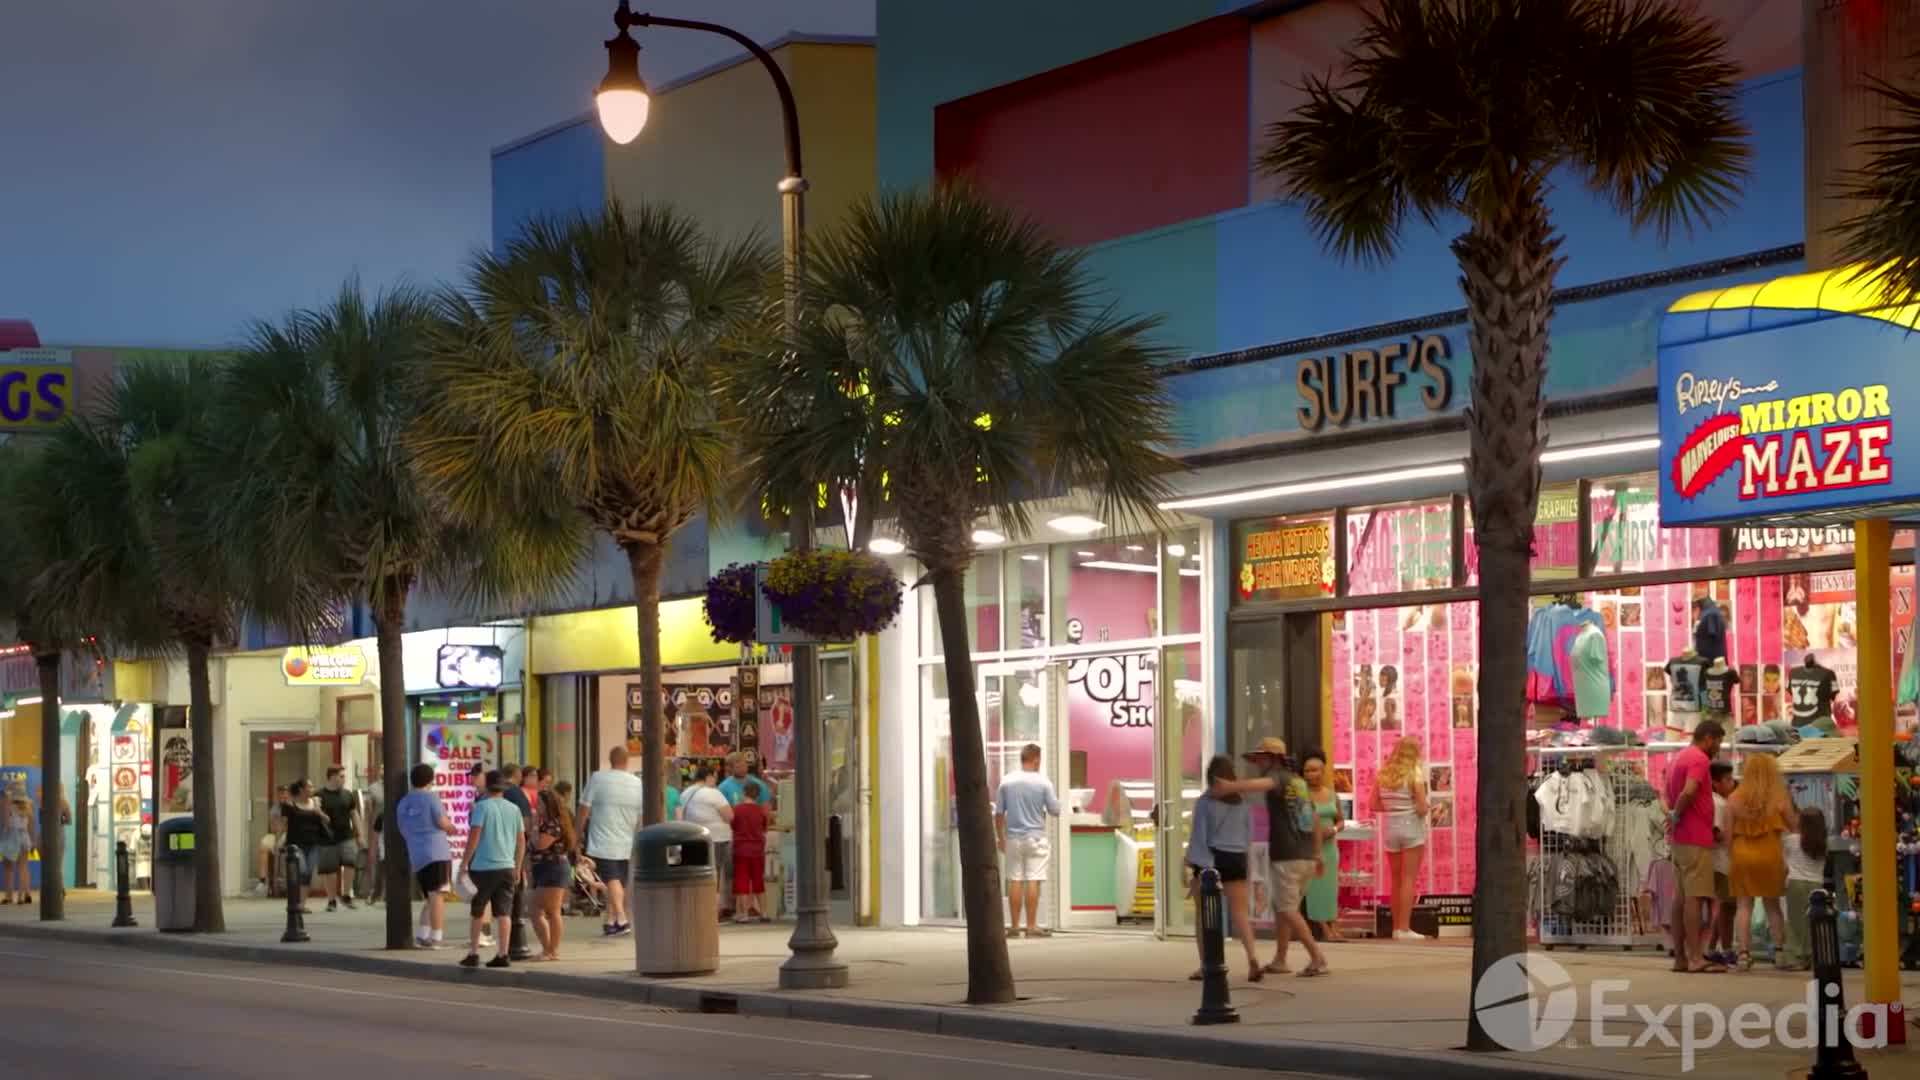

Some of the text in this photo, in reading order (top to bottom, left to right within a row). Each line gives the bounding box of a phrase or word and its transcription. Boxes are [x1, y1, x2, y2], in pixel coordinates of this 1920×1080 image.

[1297, 335, 1452, 431] SURF'S
[1741, 425, 1889, 496] MAZE
[438, 745, 481, 760] SALE
